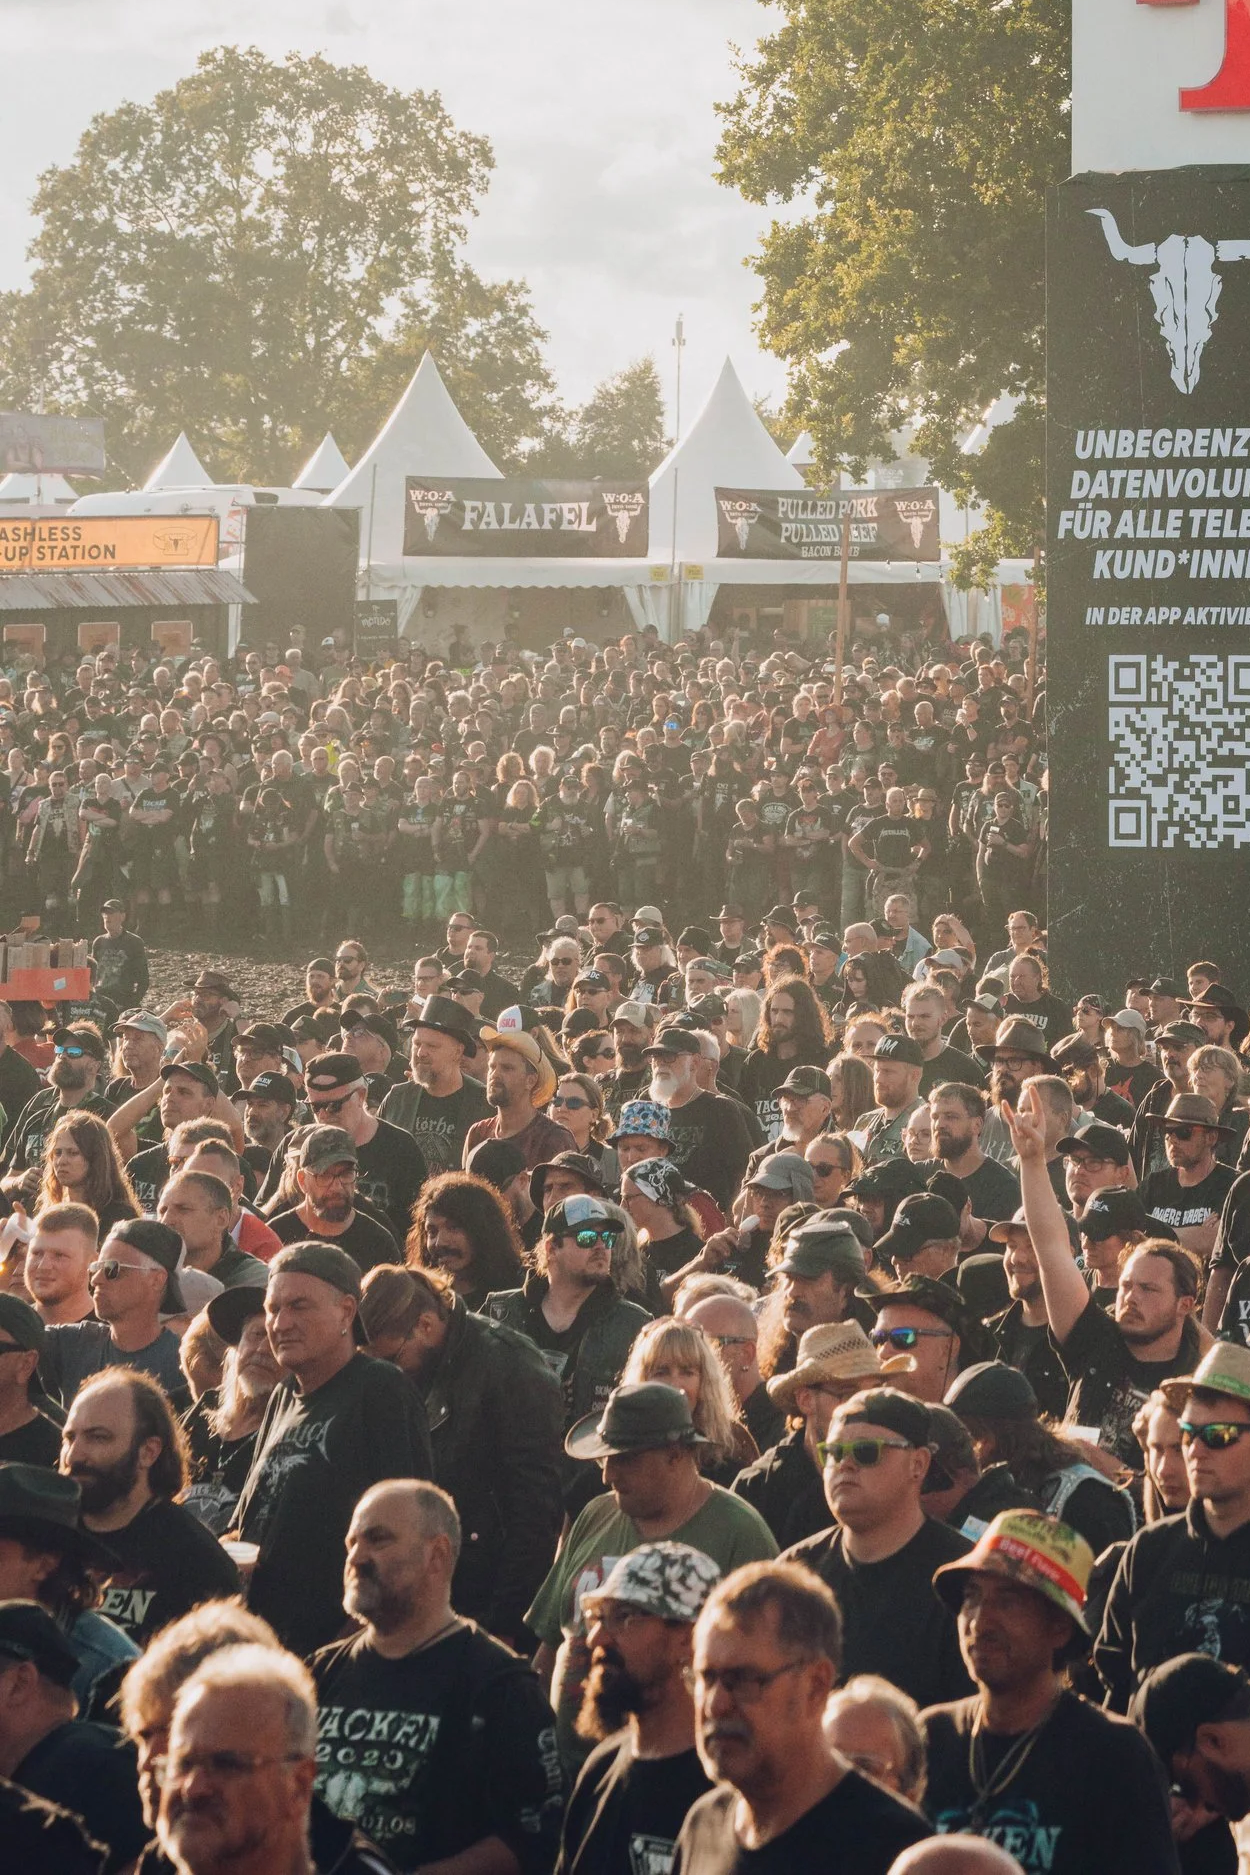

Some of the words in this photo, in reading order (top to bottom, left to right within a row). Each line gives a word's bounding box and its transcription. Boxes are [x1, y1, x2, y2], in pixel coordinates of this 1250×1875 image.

[461, 499, 598, 532] FALAFEL
[777, 497, 836, 519] PULLED
[838, 496, 879, 519] PORK
[1057, 502, 1113, 540] FÜR
[1113, 509, 1183, 539] ALLE
[0, 525, 83, 543] ASHLESS
[780, 522, 839, 543] PULLED
[840, 522, 878, 542] EEF
[36, 543, 117, 561] STATION
[801, 545, 832, 559] BACON
[1085, 606, 1105, 626] IN
[1107, 606, 1145, 626] DER
[1146, 606, 1181, 626] APP
